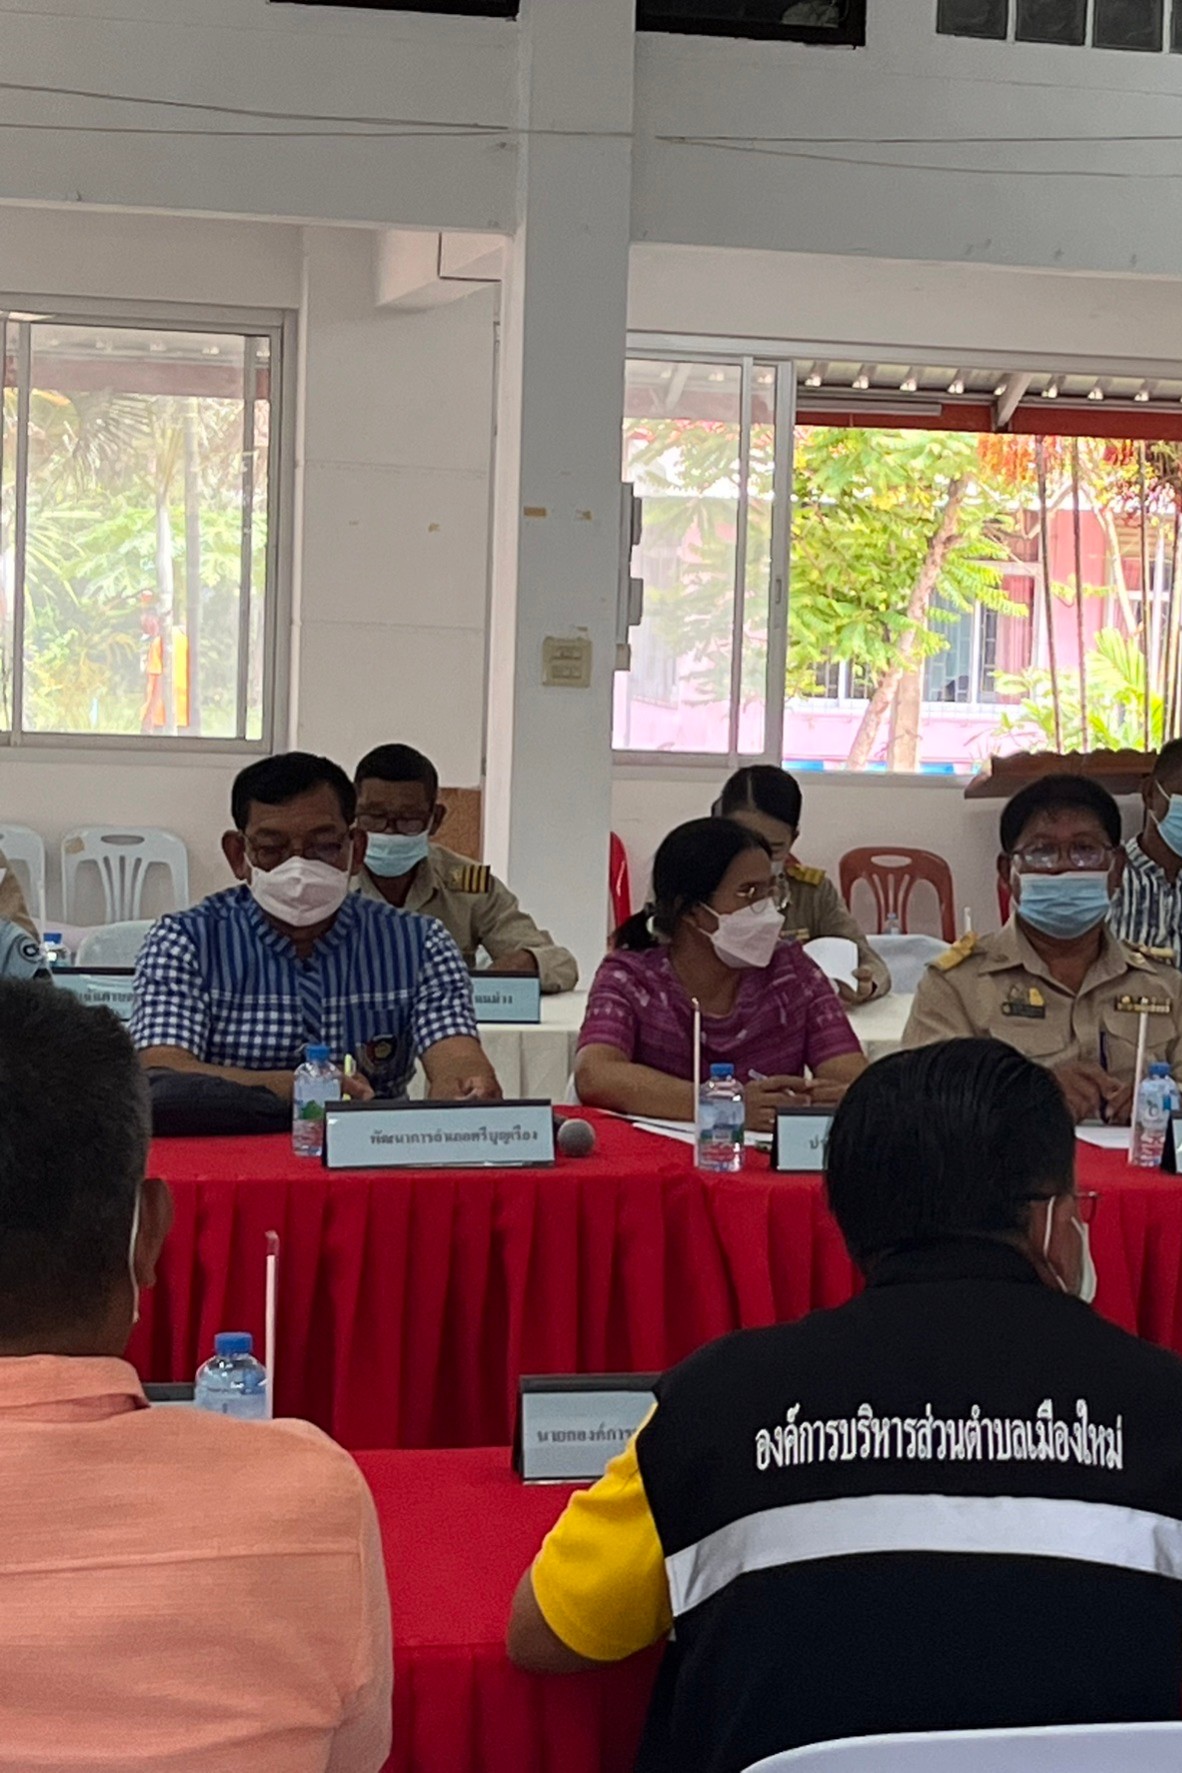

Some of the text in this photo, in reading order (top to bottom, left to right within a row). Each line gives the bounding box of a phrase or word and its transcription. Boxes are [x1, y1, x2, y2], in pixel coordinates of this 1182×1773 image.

[537, 1422, 636, 1442] นายกองค์การ
[755, 1399, 1123, 1470] องค์การบริหารส่วนตำบลเมืองใหม่
